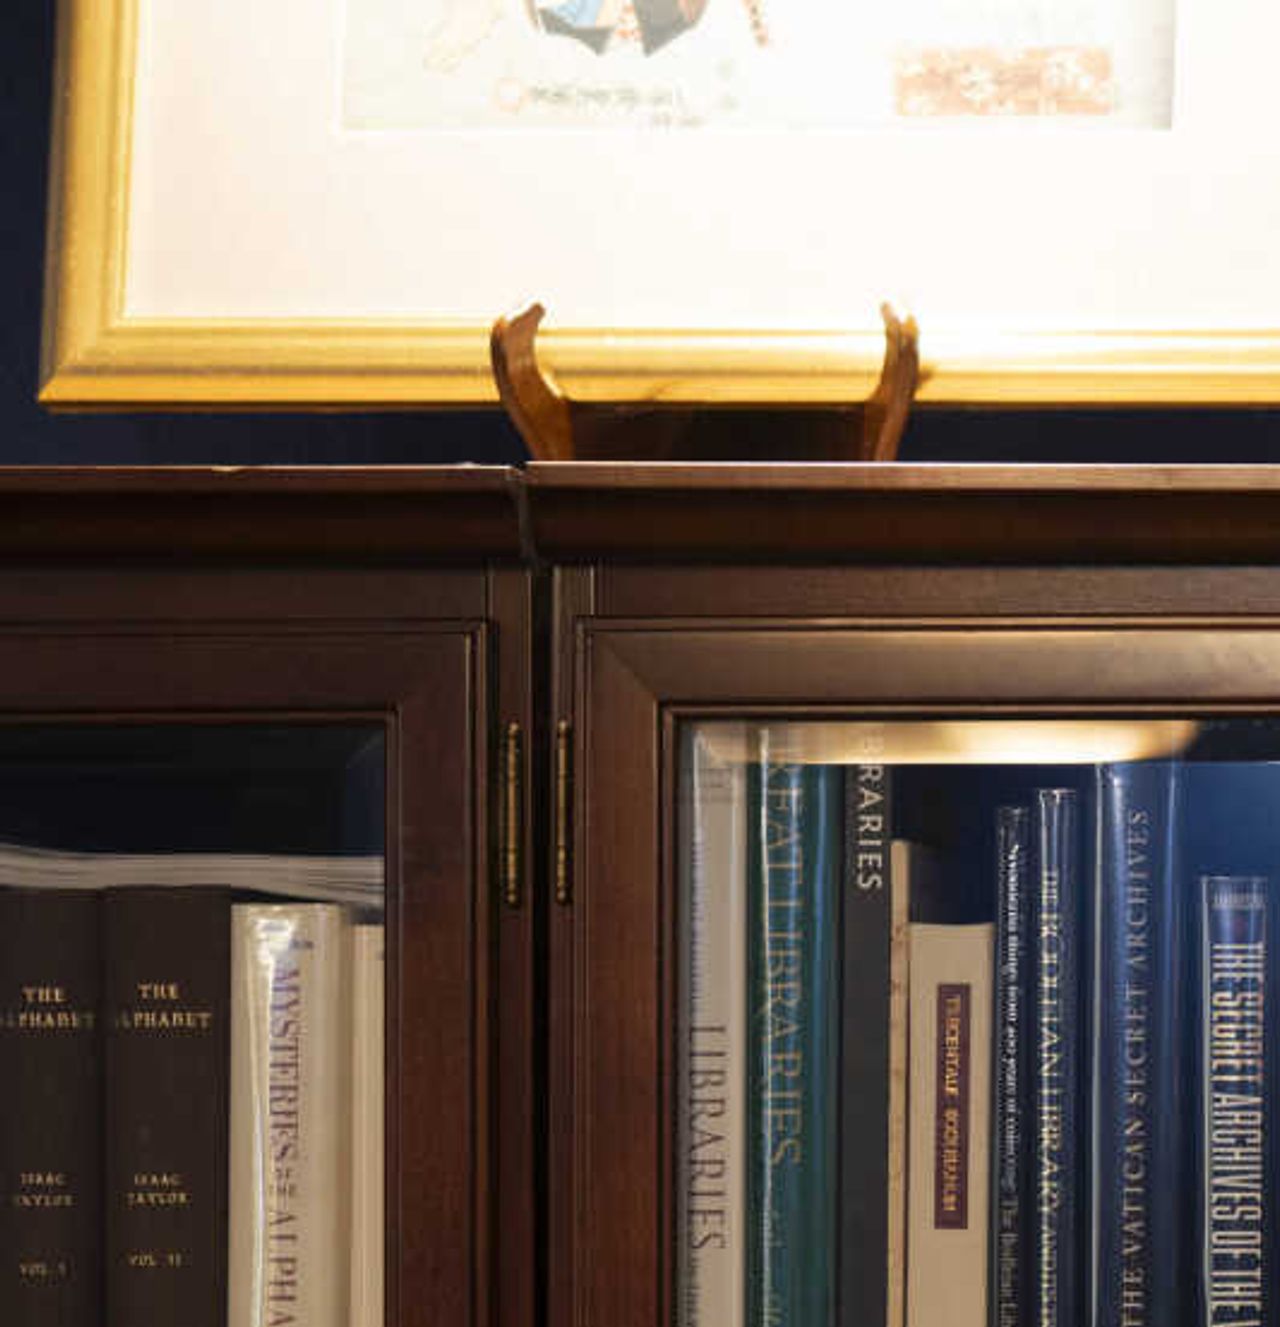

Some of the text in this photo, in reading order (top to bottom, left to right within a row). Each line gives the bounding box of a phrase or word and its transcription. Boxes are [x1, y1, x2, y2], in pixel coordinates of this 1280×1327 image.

[137, 983, 180, 1000] THE
[1210, 943, 1263, 983] THE
[268, 966, 300, 1163] MYSTERIES
[1123, 808, 1149, 1327] THE VATICAN SECRET ARCHIVES
[1210, 989, 1263, 1082] SECRET
[689, 1026, 727, 1250] LIBRARIES
[1210, 1092, 1263, 1221] ARCHIVES
[1210, 1229, 1263, 1257] OF
[1210, 1266, 1263, 1311] THE
